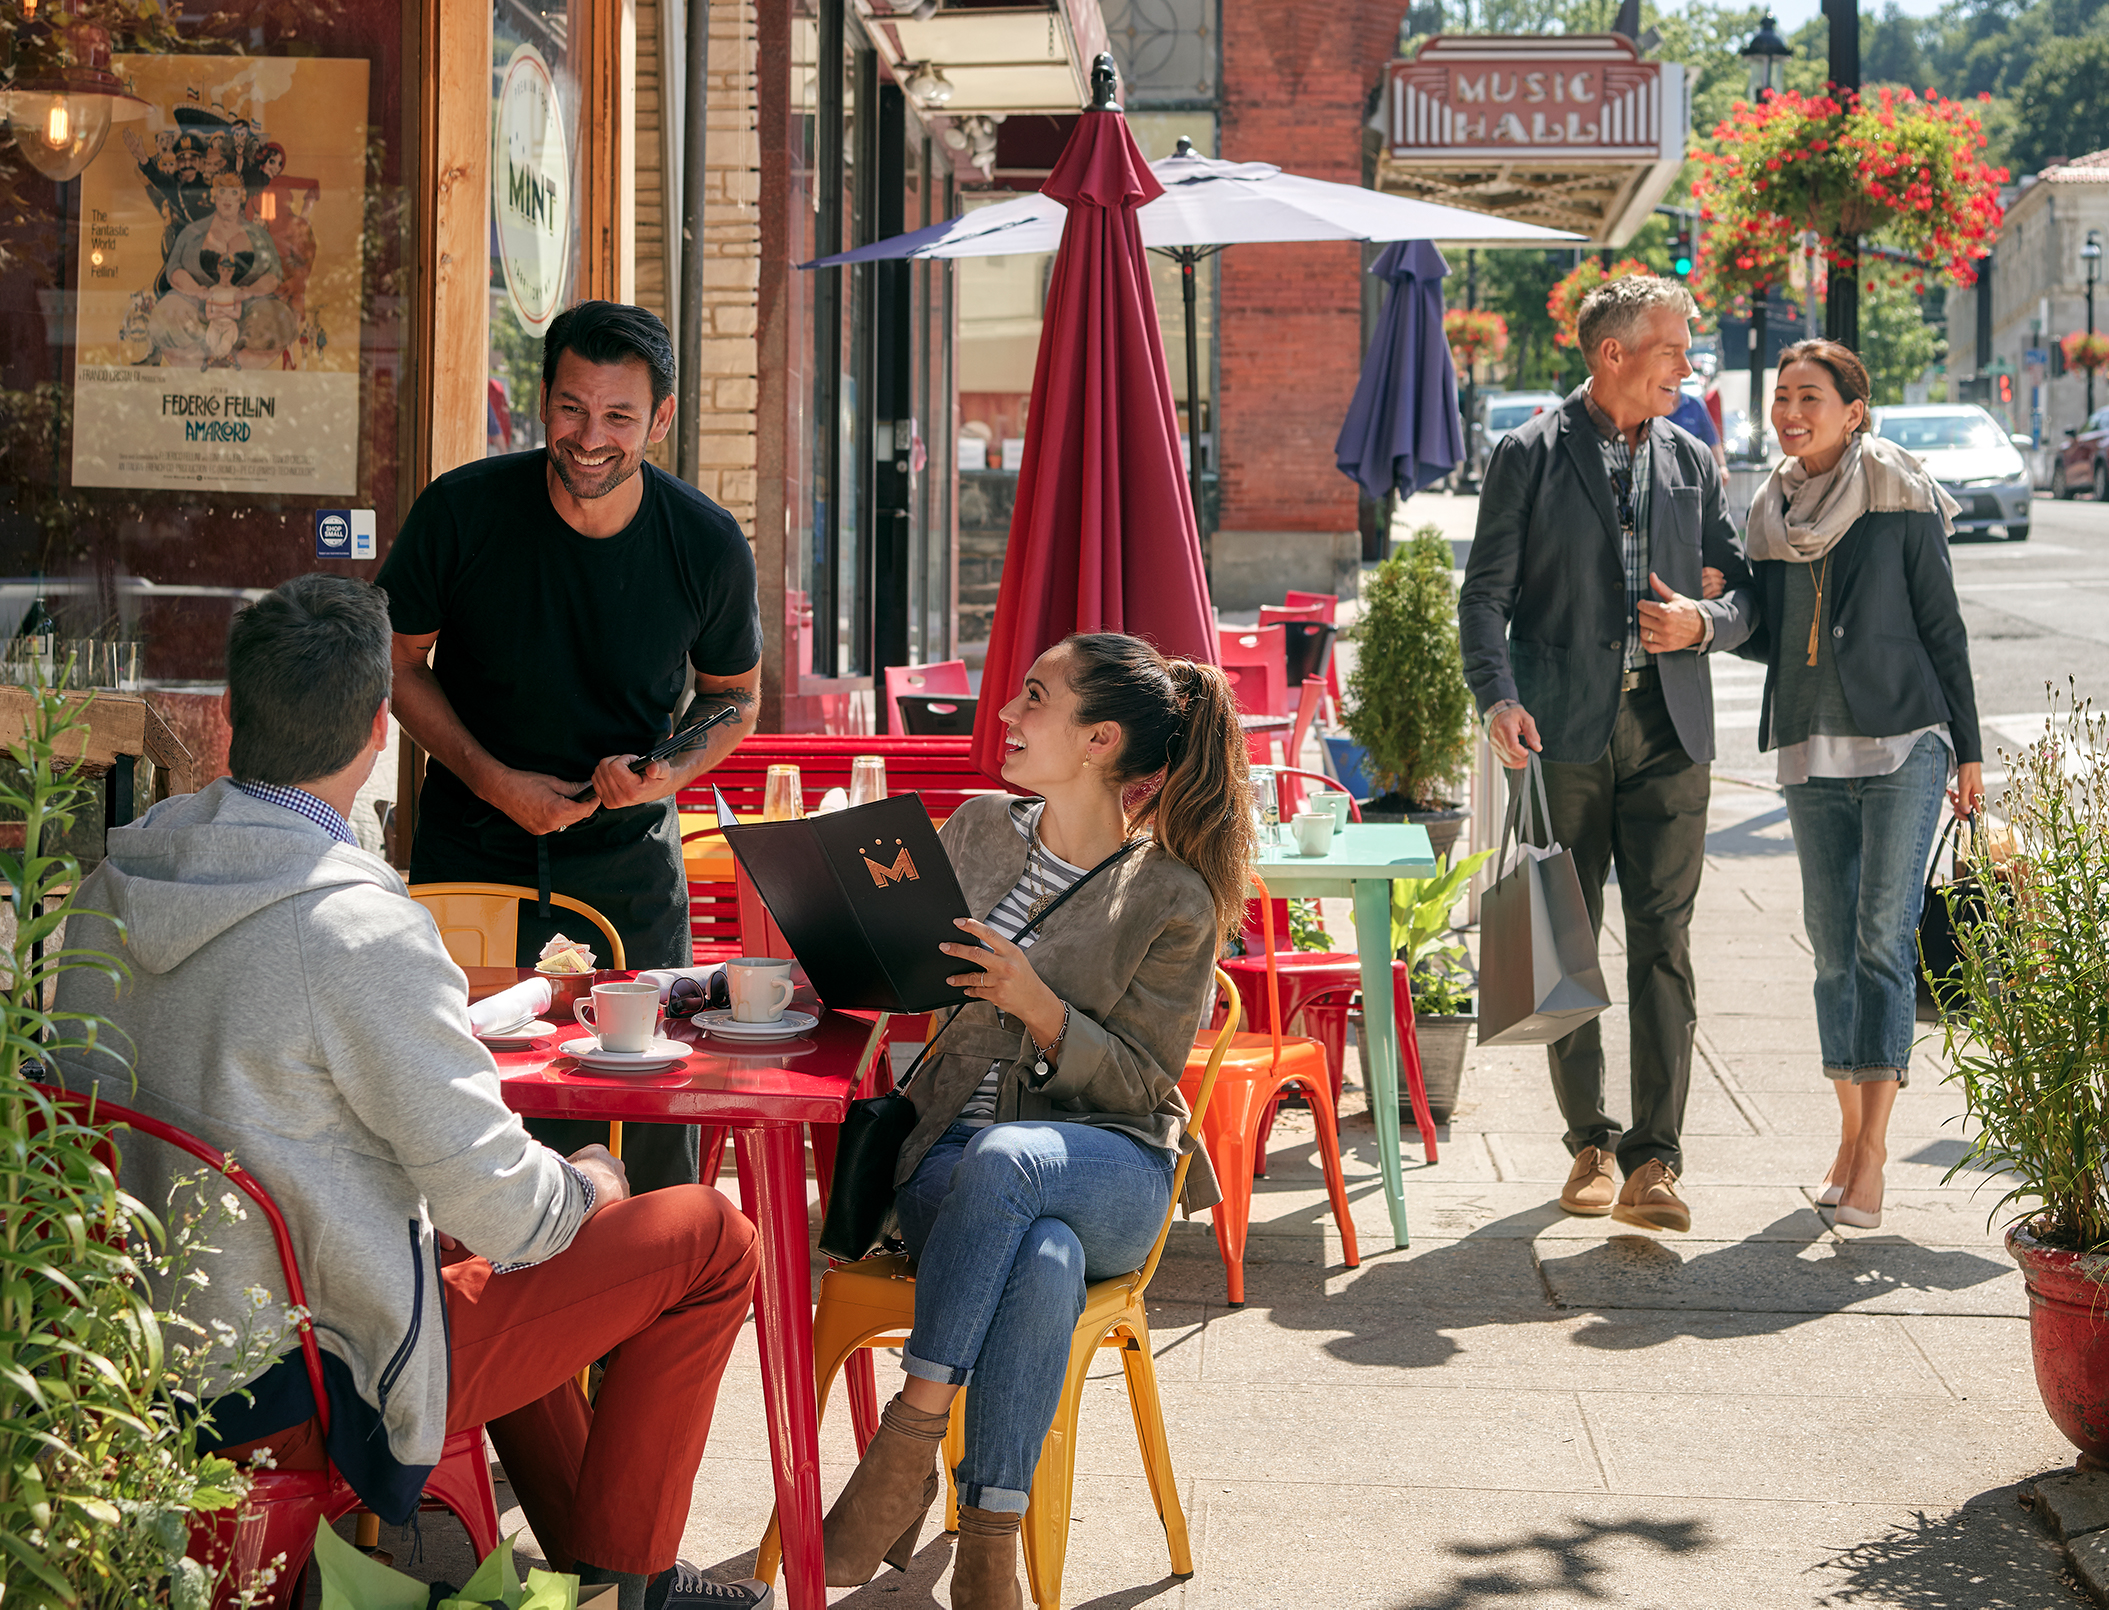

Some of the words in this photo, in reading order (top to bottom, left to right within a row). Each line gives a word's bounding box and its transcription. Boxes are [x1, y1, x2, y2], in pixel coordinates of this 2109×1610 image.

[1456, 71, 1596, 104] MUSIC
[1453, 111, 1600, 144] HALL
[509, 154, 557, 238] MINT
[91, 209, 108, 222] The
[91, 223, 129, 237] Fantastic
[91, 238, 116, 250] World
[91, 265, 119, 278] Fellini!
[162, 394, 220, 417] FEDERICO
[224, 396, 275, 418] FELLINI
[185, 420, 251, 443] AMARCORD
